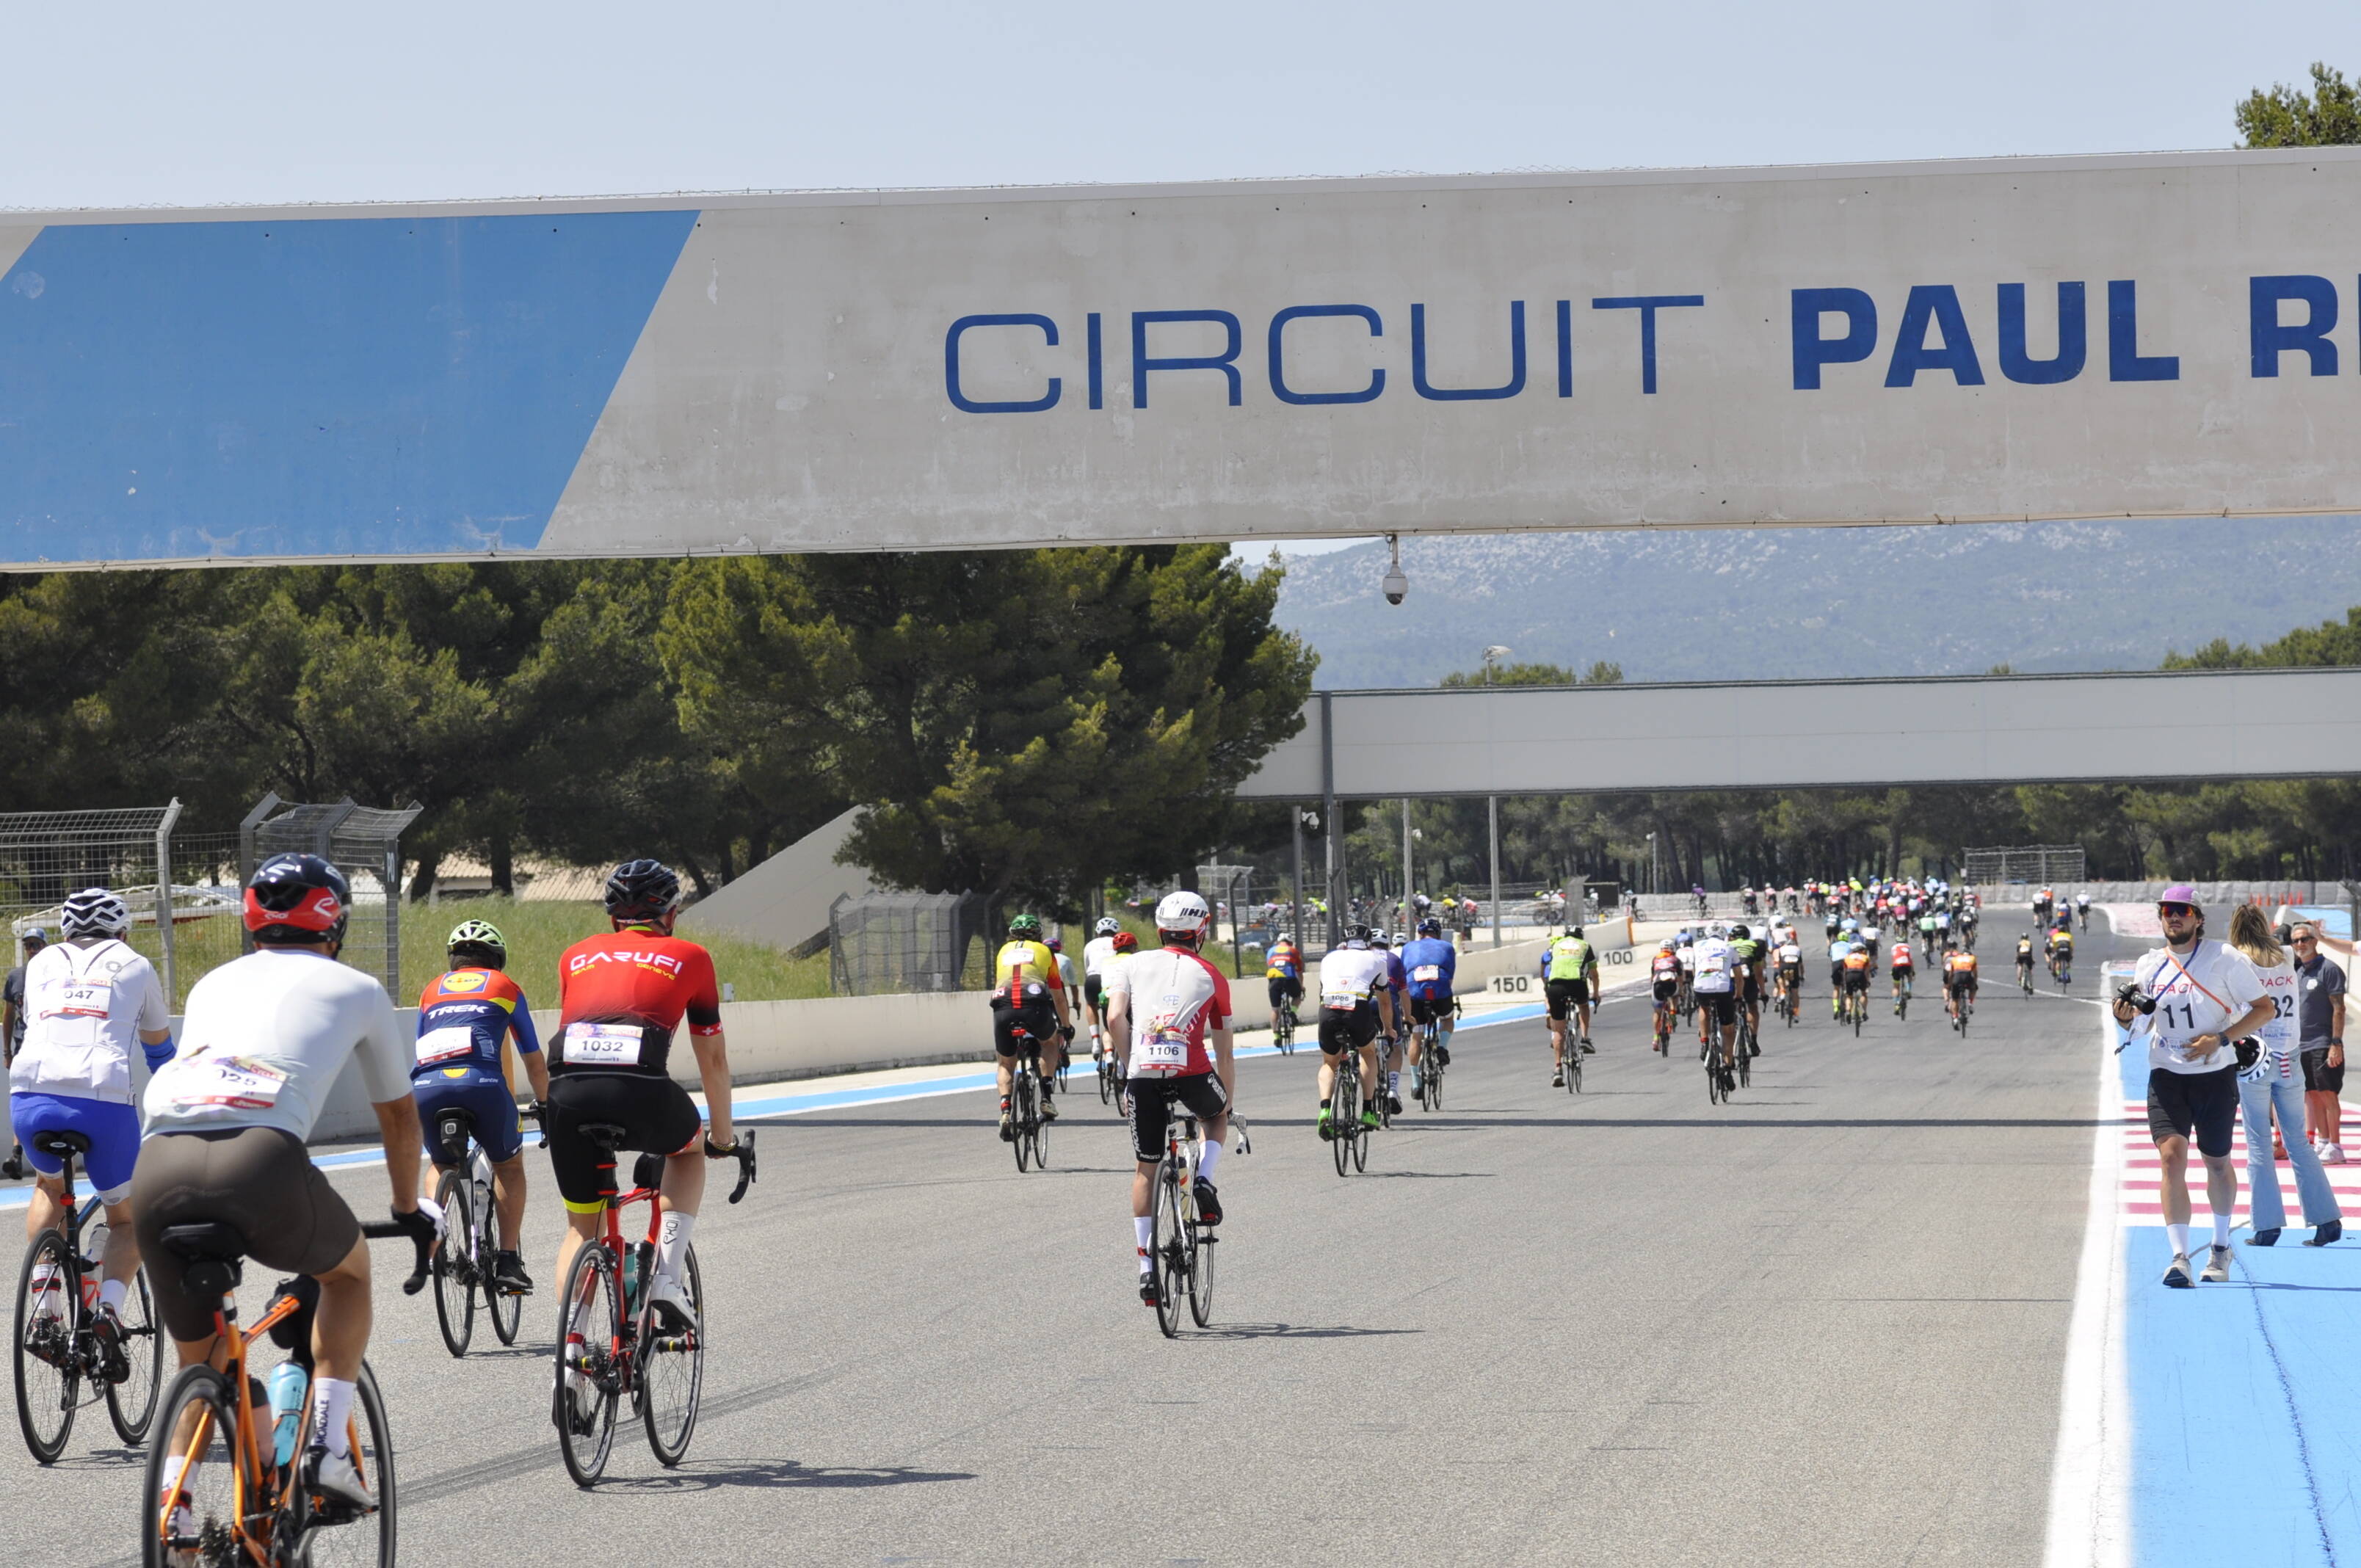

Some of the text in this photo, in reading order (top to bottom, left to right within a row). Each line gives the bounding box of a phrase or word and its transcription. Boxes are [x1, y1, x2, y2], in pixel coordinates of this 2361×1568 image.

[946, 274, 2361, 414] CIRCUIT PAUL R
[570, 951, 682, 975] GARUFI
[1603, 951, 1633, 965] 100
[571, 964, 595, 977] TEAM
[1493, 977, 1528, 992] 150
[2259, 975, 2293, 988] RACK
[429, 1004, 490, 1020] TREK
[2162, 1003, 2194, 1028] 11
[582, 1040, 623, 1051] 1032
[1149, 1046, 1179, 1056] 1106
[1125, 1093, 1142, 1153] MONDIALE
